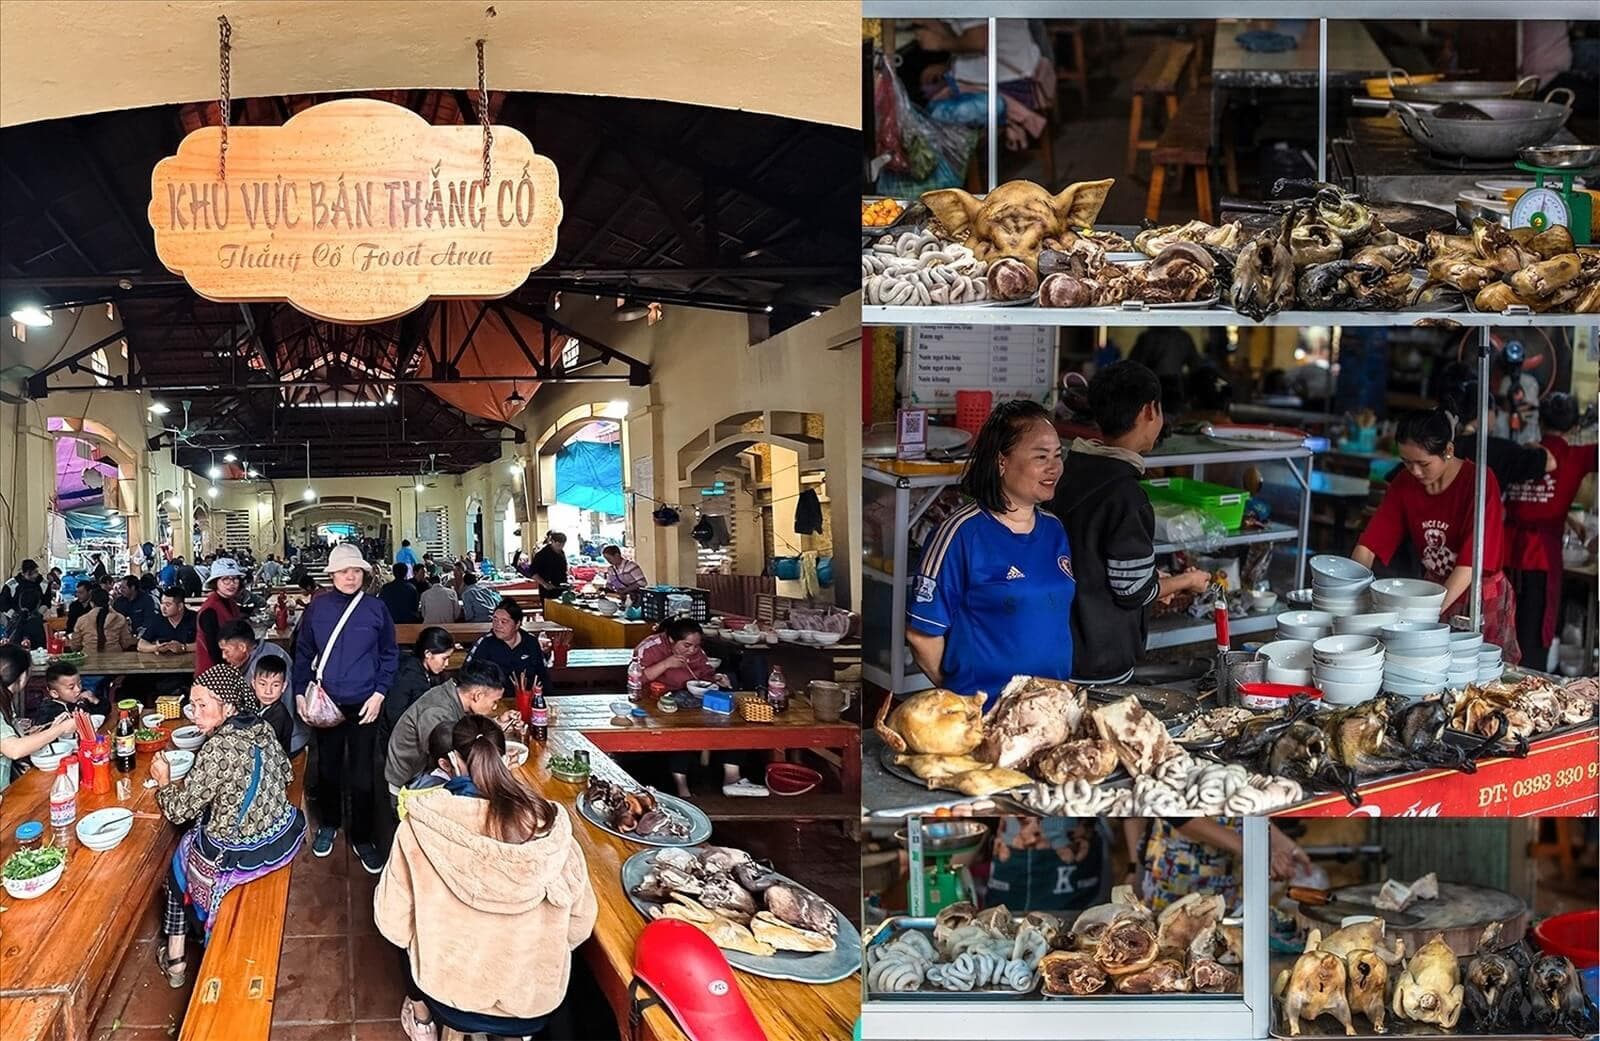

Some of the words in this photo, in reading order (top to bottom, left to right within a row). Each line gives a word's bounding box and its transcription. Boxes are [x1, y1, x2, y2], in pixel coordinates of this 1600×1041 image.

[167, 182, 229, 231] KHU
[240, 174, 300, 240] VỰC
[309, 172, 373, 231] BÁN
[384, 159, 487, 232] THẮNG
[497, 160, 536, 228] CỐ
[312, 242, 345, 268] Cố
[352, 242, 423, 272] Food
[430, 241, 493, 266] Area
[1478, 783, 1508, 807] ĐT:
[1512, 773, 1552, 798] 0393
[1555, 765, 1584, 788] 330
[1587, 762, 1599, 778] 9
[1053, 866, 1077, 894] K
